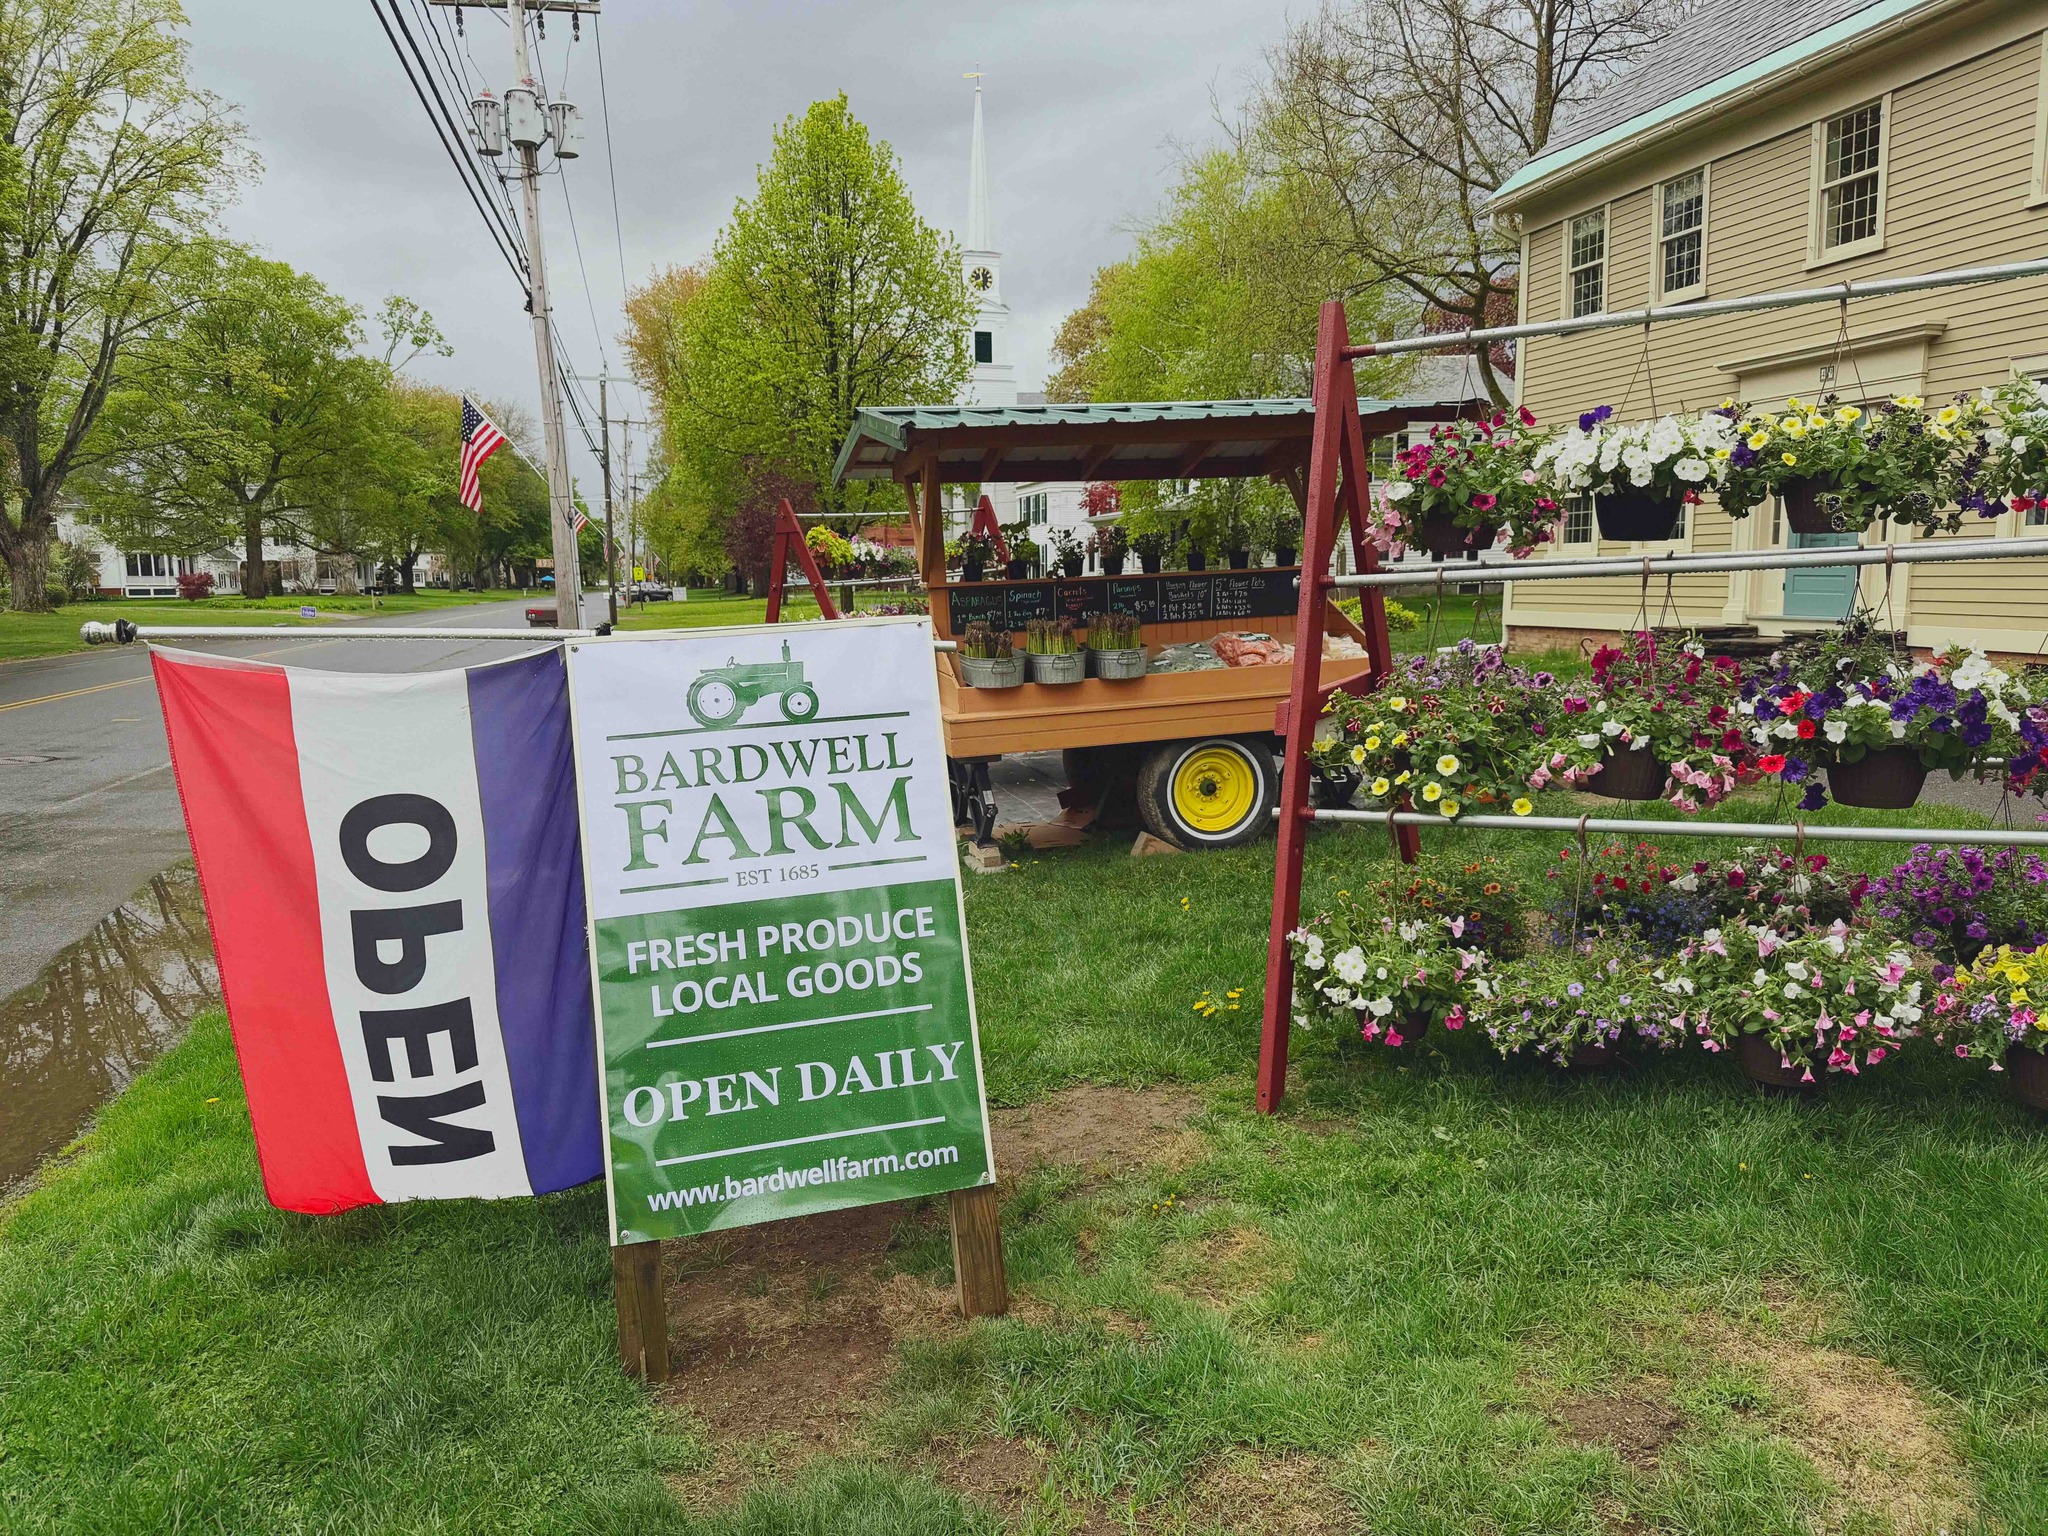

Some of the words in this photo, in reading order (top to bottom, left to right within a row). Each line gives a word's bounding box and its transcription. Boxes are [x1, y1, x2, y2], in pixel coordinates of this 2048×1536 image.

[1009, 590, 1042, 602] Spinach
[1058, 586, 1087, 597] Carrots
[1229, 579, 1249, 588] Flower
[1251, 577, 1265, 587] Pots
[610, 732, 914, 795] BARDWELL
[614, 776, 922, 872] FARM
[736, 868, 772, 887] EST
[779, 864, 819, 882] 1685
[627, 928, 747, 974] FRESH
[757, 906, 936, 958] PRODUCE
[651, 972, 779, 1017] LOCAL
[787, 952, 923, 997] GOODS
[623, 1067, 782, 1127] OPEN
[795, 1041, 965, 1102] DAILY
[647, 1145, 958, 1212] www.bardwellfarm.com
